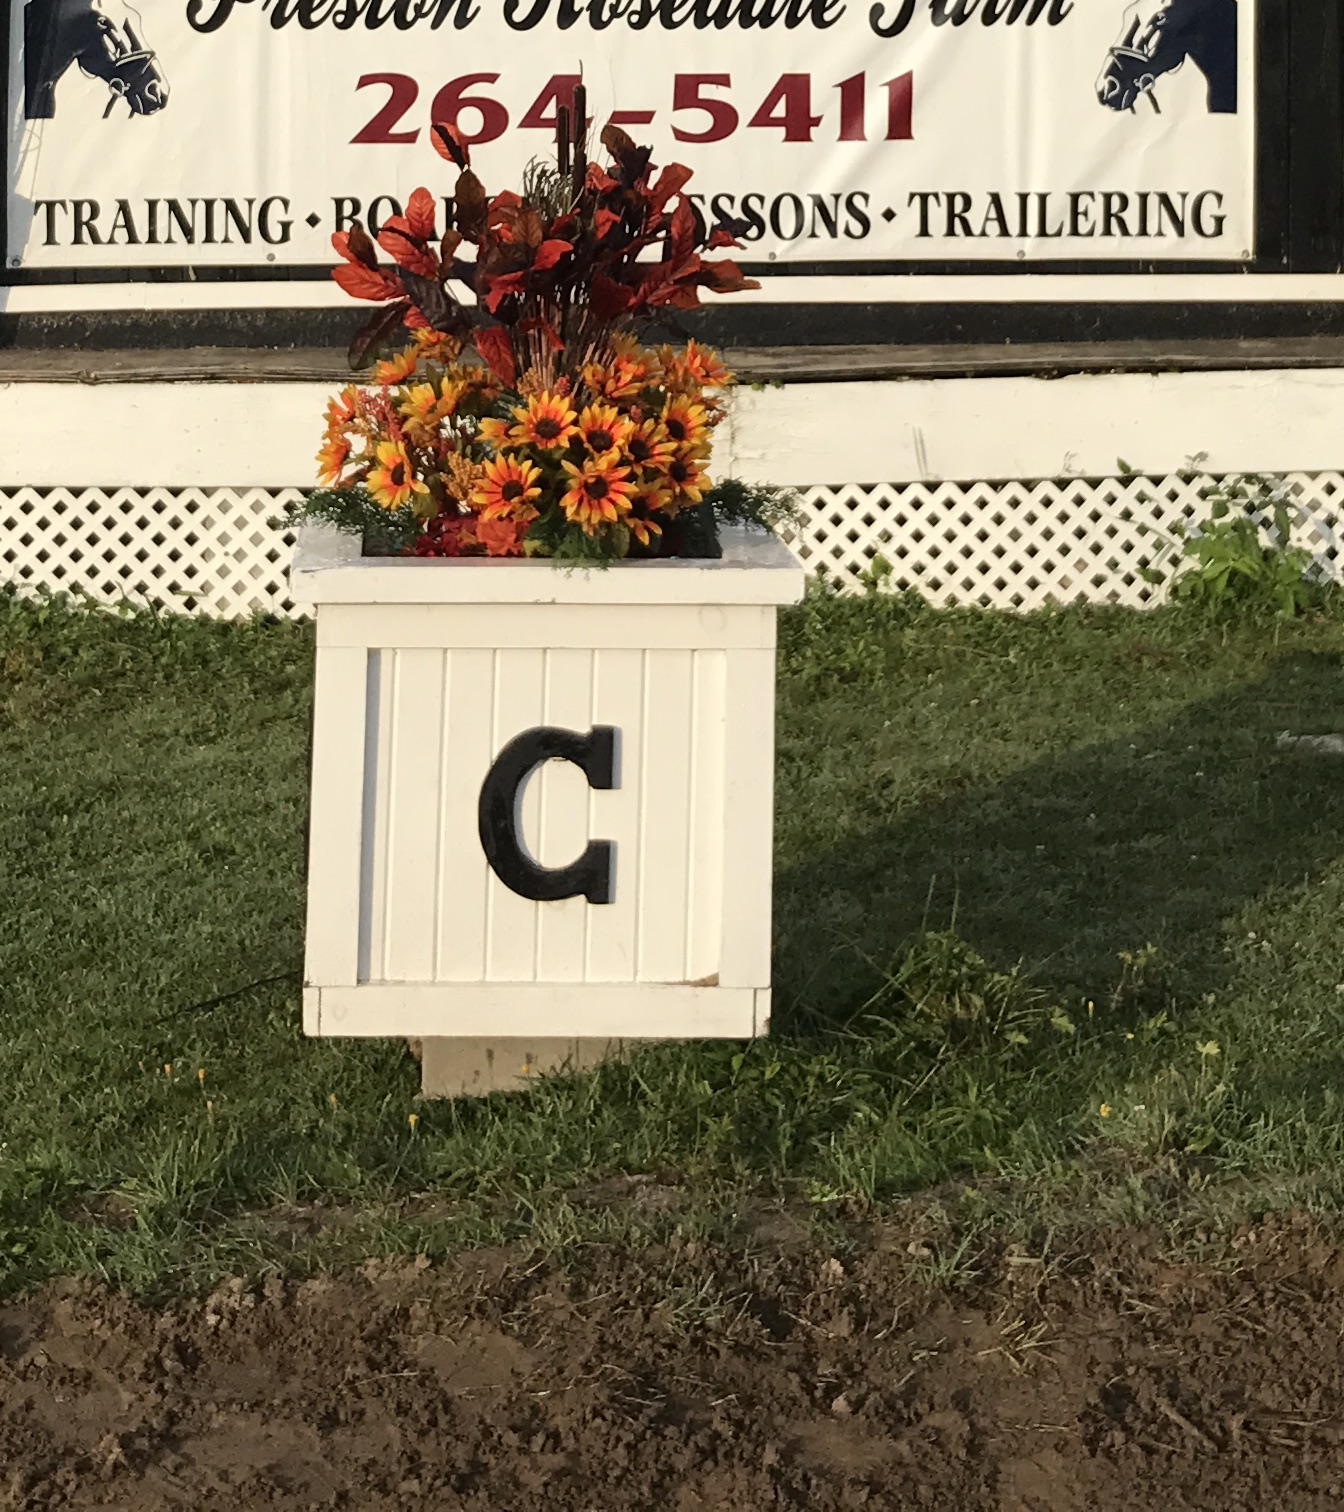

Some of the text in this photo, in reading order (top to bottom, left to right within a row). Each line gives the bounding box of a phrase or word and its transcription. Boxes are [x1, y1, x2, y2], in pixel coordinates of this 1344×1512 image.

[347, 69, 916, 146] 264-5411
[32, 195, 293, 247] TRAINING
[687, 190, 872, 242] SSONS
[907, 190, 1228, 241] TRAILERING
[477, 724, 621, 905] C
